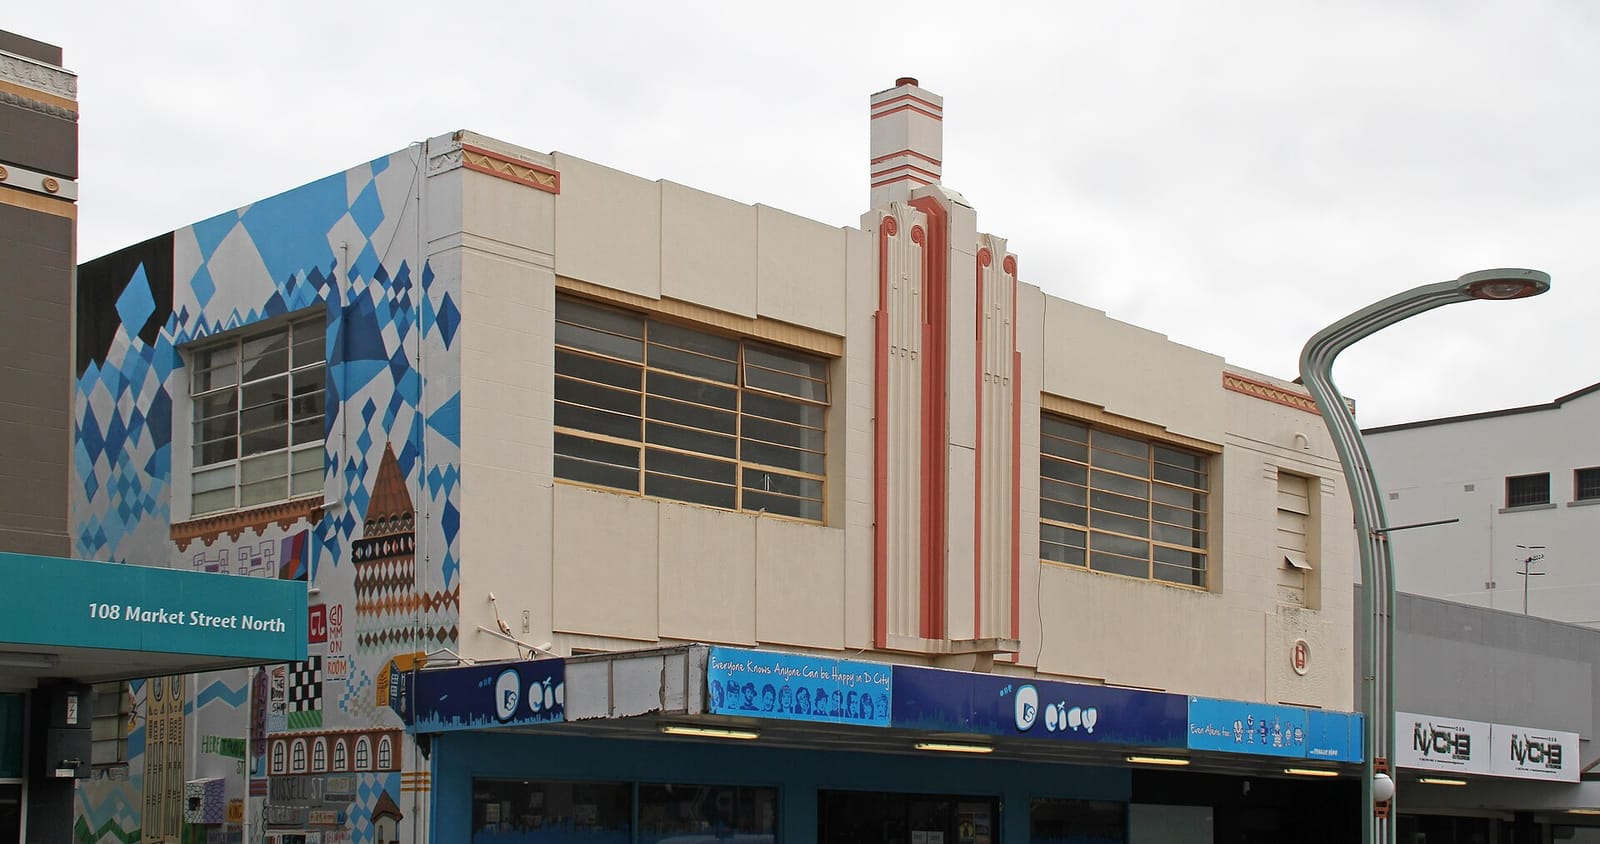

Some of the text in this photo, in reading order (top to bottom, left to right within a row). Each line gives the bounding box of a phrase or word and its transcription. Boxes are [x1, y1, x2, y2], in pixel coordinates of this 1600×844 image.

[88, 602, 286, 633] 108 Market Street North
[327, 660, 347, 675] ROOM
[711, 656, 746, 677] Everyone
[747, 660, 772, 675] Knows
[774, 663, 801, 682] Anyone
[802, 665, 819, 679] Can
[820, 666, 830, 680] be
[832, 665, 855, 688] Happy
[863, 671, 872, 683] D
[873, 672, 890, 691] City
[310, 776, 325, 800] ST
